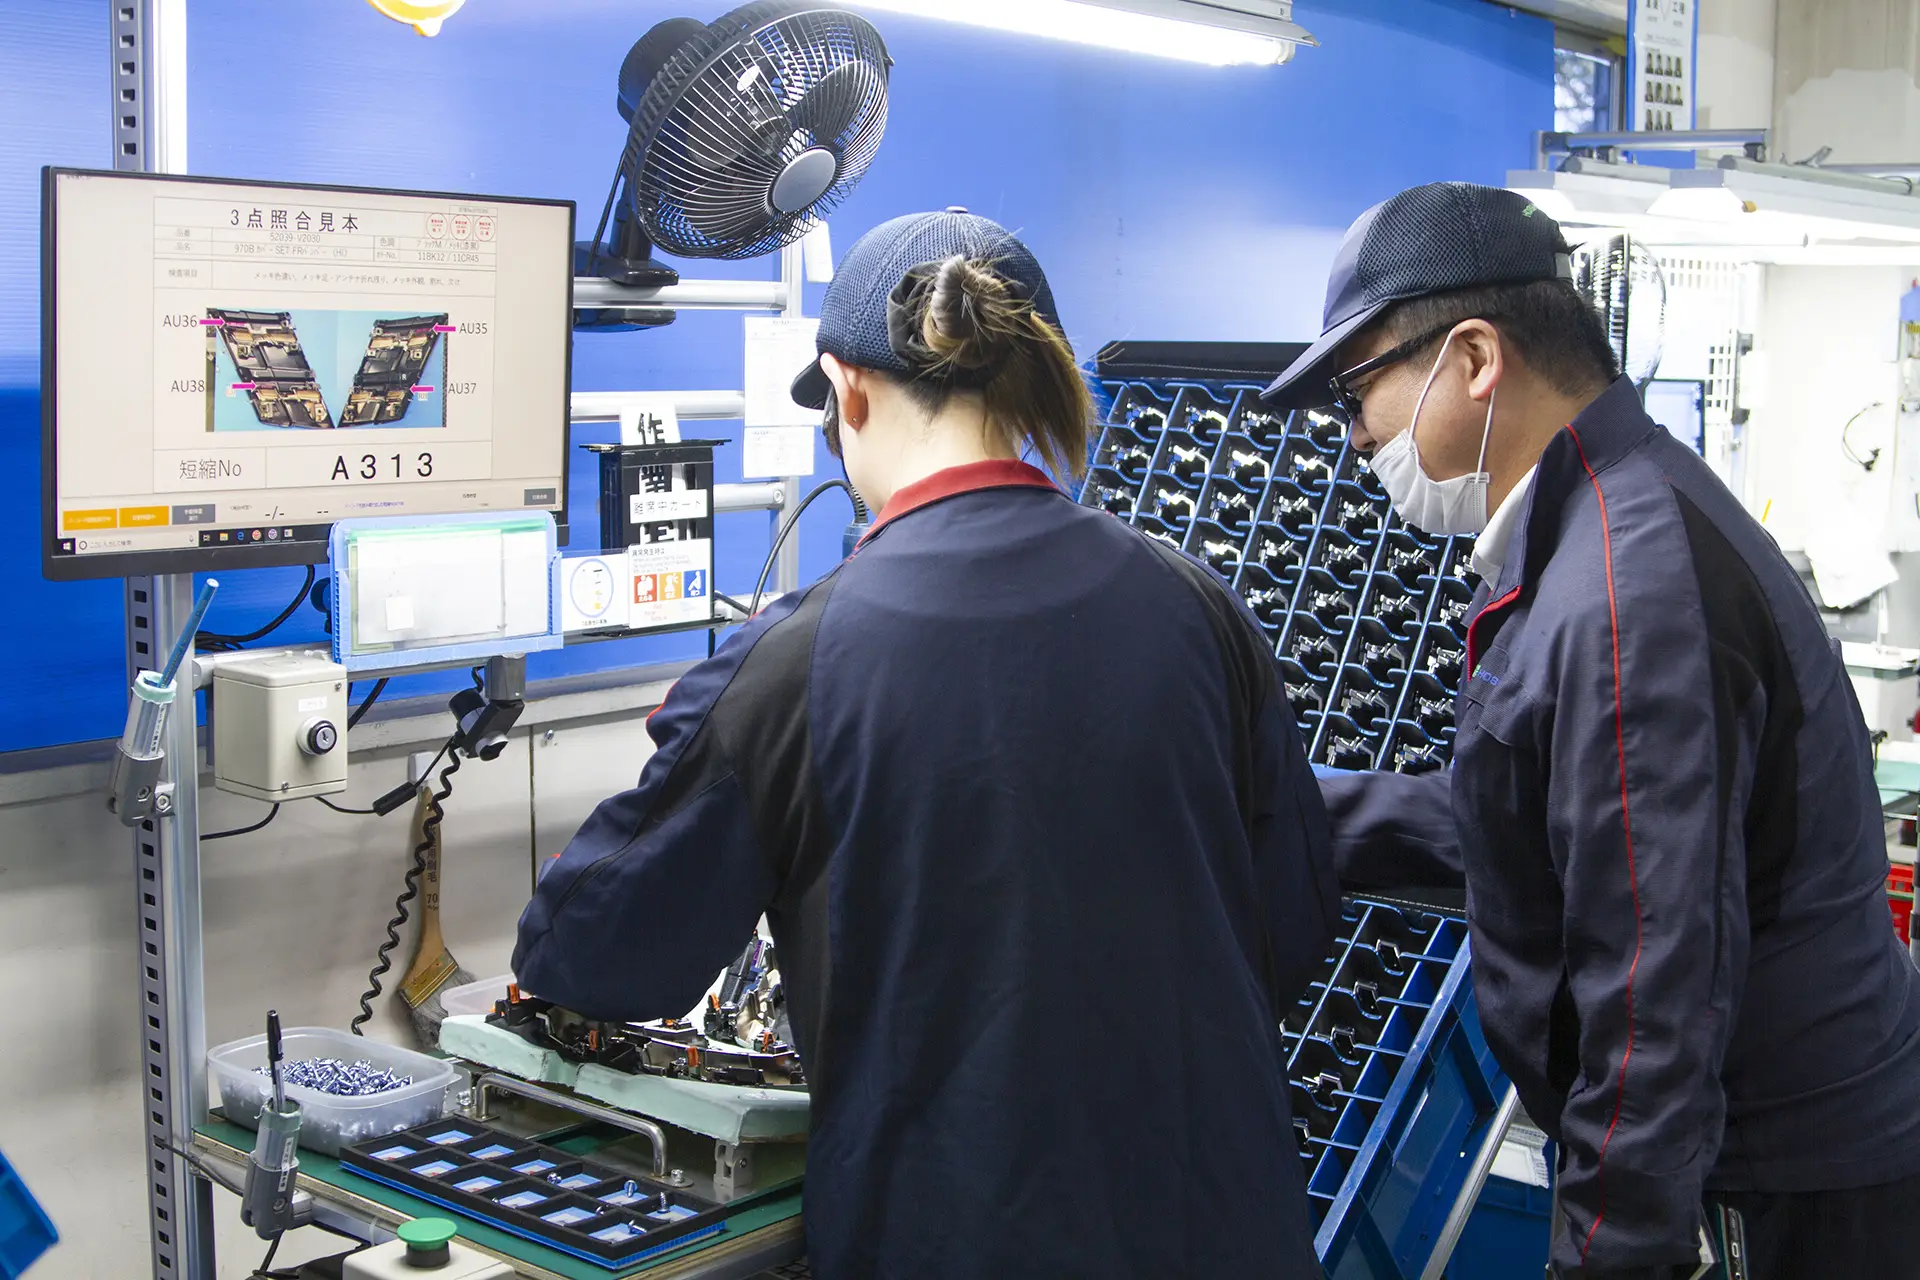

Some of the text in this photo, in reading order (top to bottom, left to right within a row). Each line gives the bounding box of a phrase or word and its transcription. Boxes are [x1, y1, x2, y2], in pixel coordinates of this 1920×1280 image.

[231, 208, 358, 234] 3点照合見本
[163, 314, 198, 328] AU36
[460, 322, 488, 335] AU35
[171, 380, 205, 393] AU38
[448, 382, 477, 395] AU37
[179, 458, 242, 479] 短縮No
[331, 452, 433, 480] A313
[426, 893, 438, 904] 70
